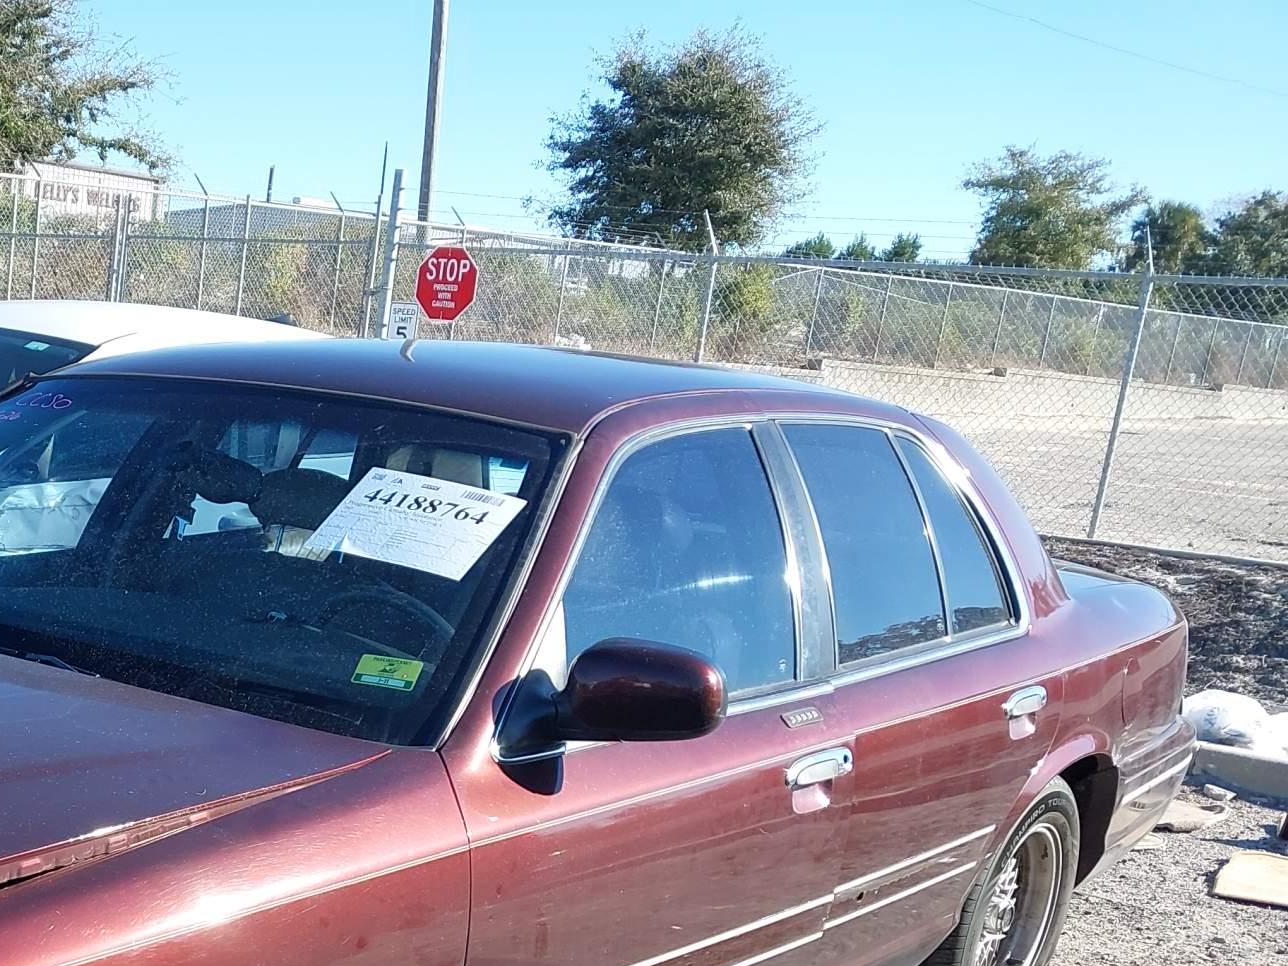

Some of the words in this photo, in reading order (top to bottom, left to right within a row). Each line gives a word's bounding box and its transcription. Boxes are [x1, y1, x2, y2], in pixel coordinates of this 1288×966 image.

[426, 257, 471, 282] STOP
[433, 283, 459, 292] PROCEED
[438, 291, 452, 300] WITH
[431, 300, 456, 308] CAUTION
[392, 307, 416, 316] SPEED
[394, 316, 413, 324] LIMIT
[396, 325, 408, 339] 5
[363, 488, 491, 525] 44188764
[1001, 804, 1046, 868] CHAMPIRO
